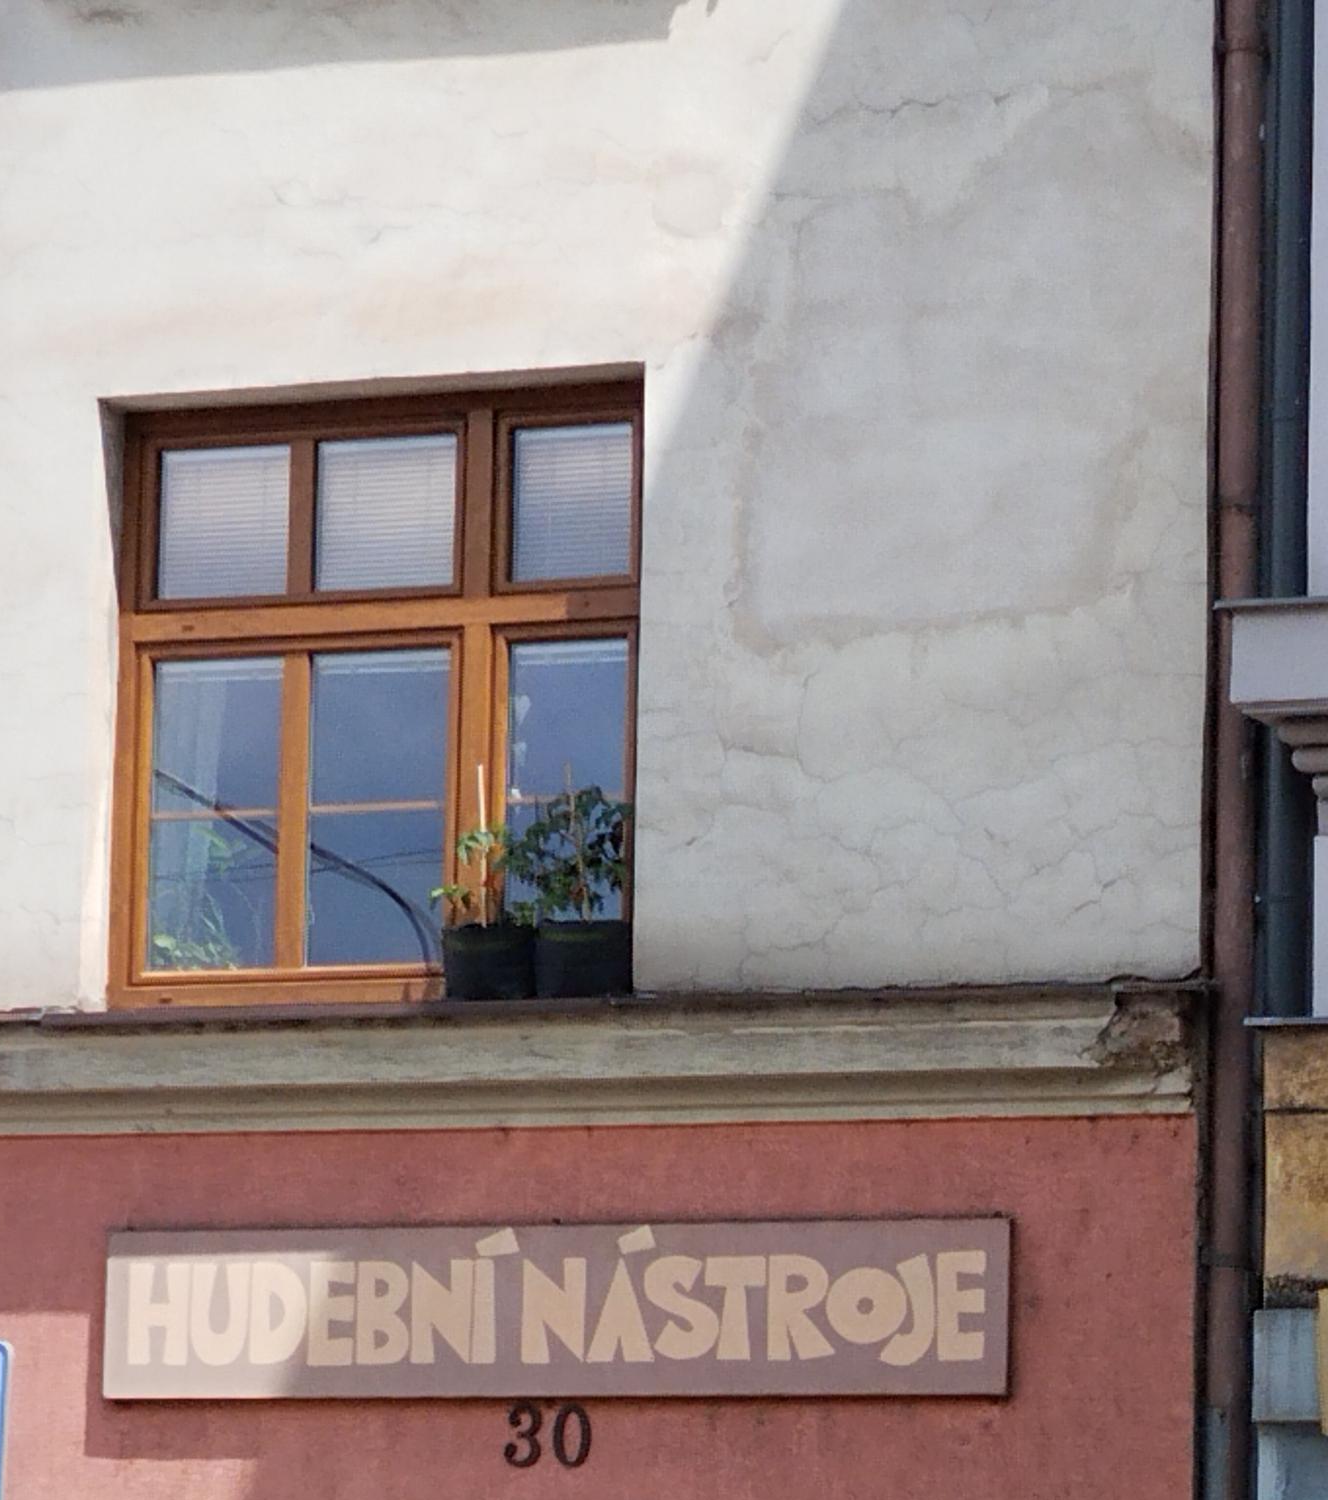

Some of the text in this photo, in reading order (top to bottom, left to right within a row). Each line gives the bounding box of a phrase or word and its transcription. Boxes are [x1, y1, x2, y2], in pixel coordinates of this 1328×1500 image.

[127, 1225, 986, 1366] HUDEBNÍ NÁSTROJE
[504, 1402, 592, 1469] 30
